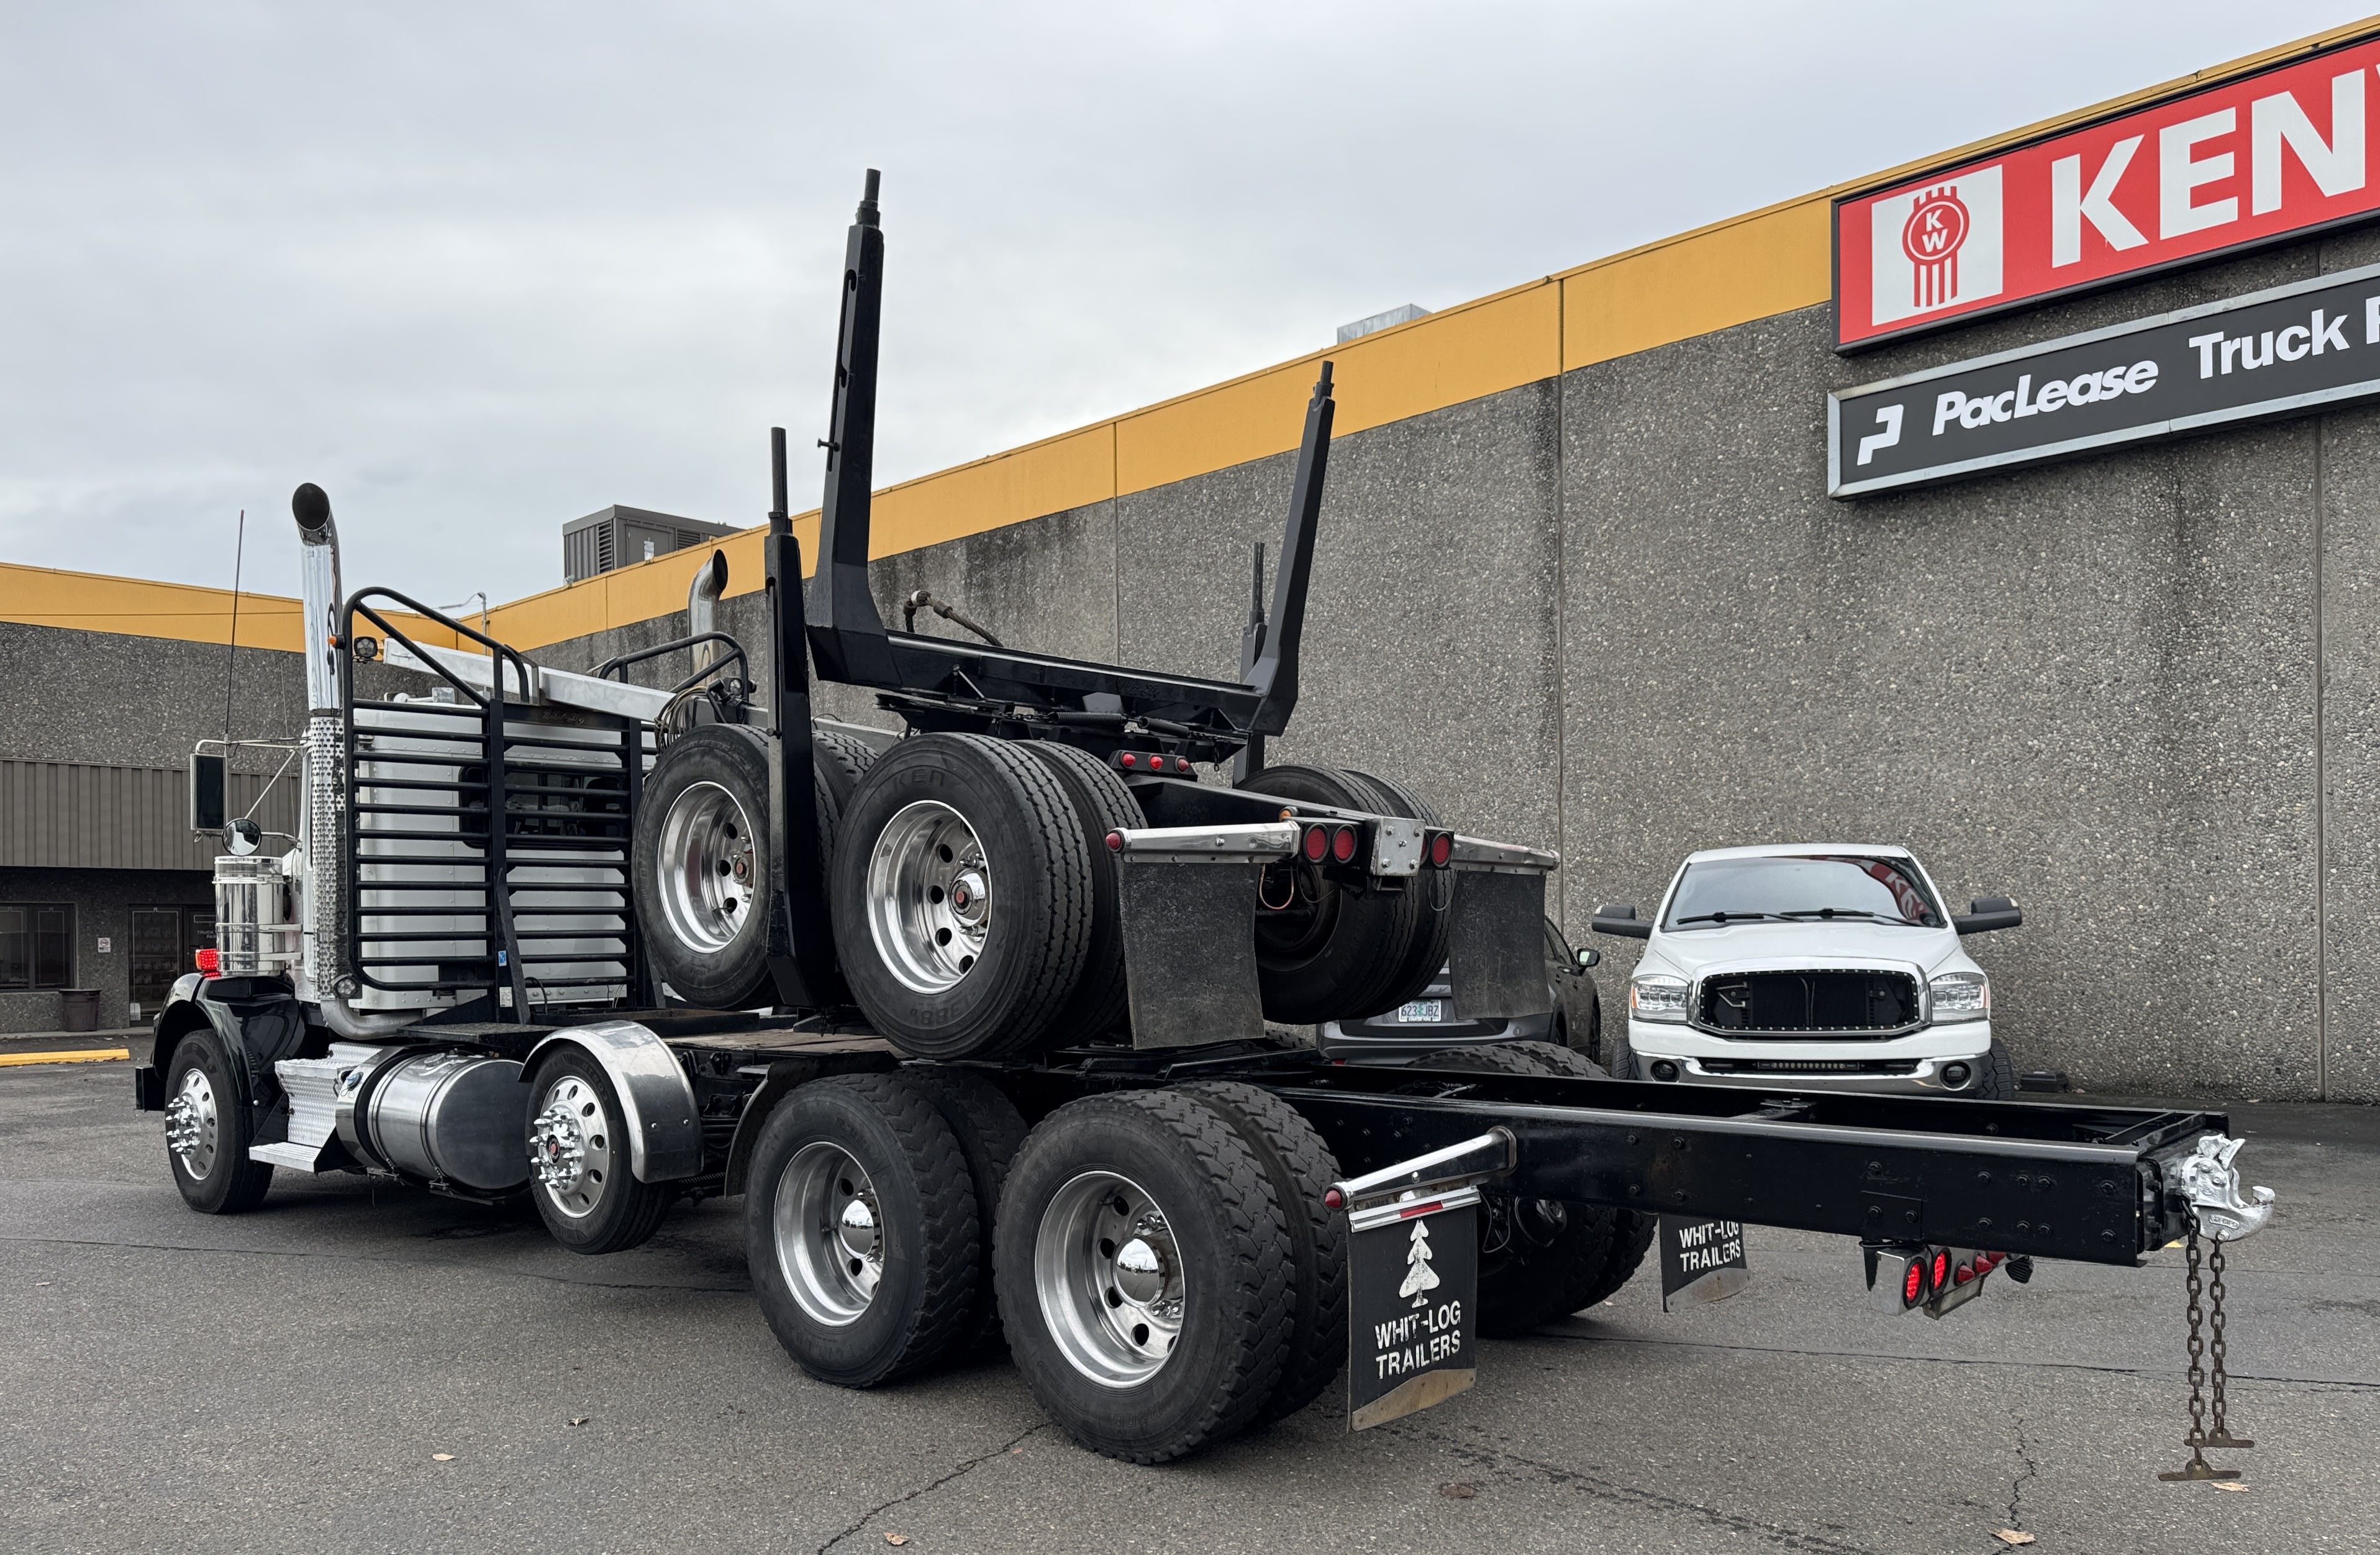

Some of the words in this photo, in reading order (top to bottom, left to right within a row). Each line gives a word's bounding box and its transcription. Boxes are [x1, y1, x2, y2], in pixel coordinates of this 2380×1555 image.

[2051, 63, 2380, 269] KEN
[1932, 360, 2159, 436] PacLease
[2189, 309, 2351, 380] Truck
[1679, 1220, 1740, 1249] WHIT-LOG
[1679, 1238, 1741, 1272] TRAILERS
[1374, 1300, 1461, 1350] WHIT-LOG
[1375, 1329, 1461, 1380] TRAILERS
